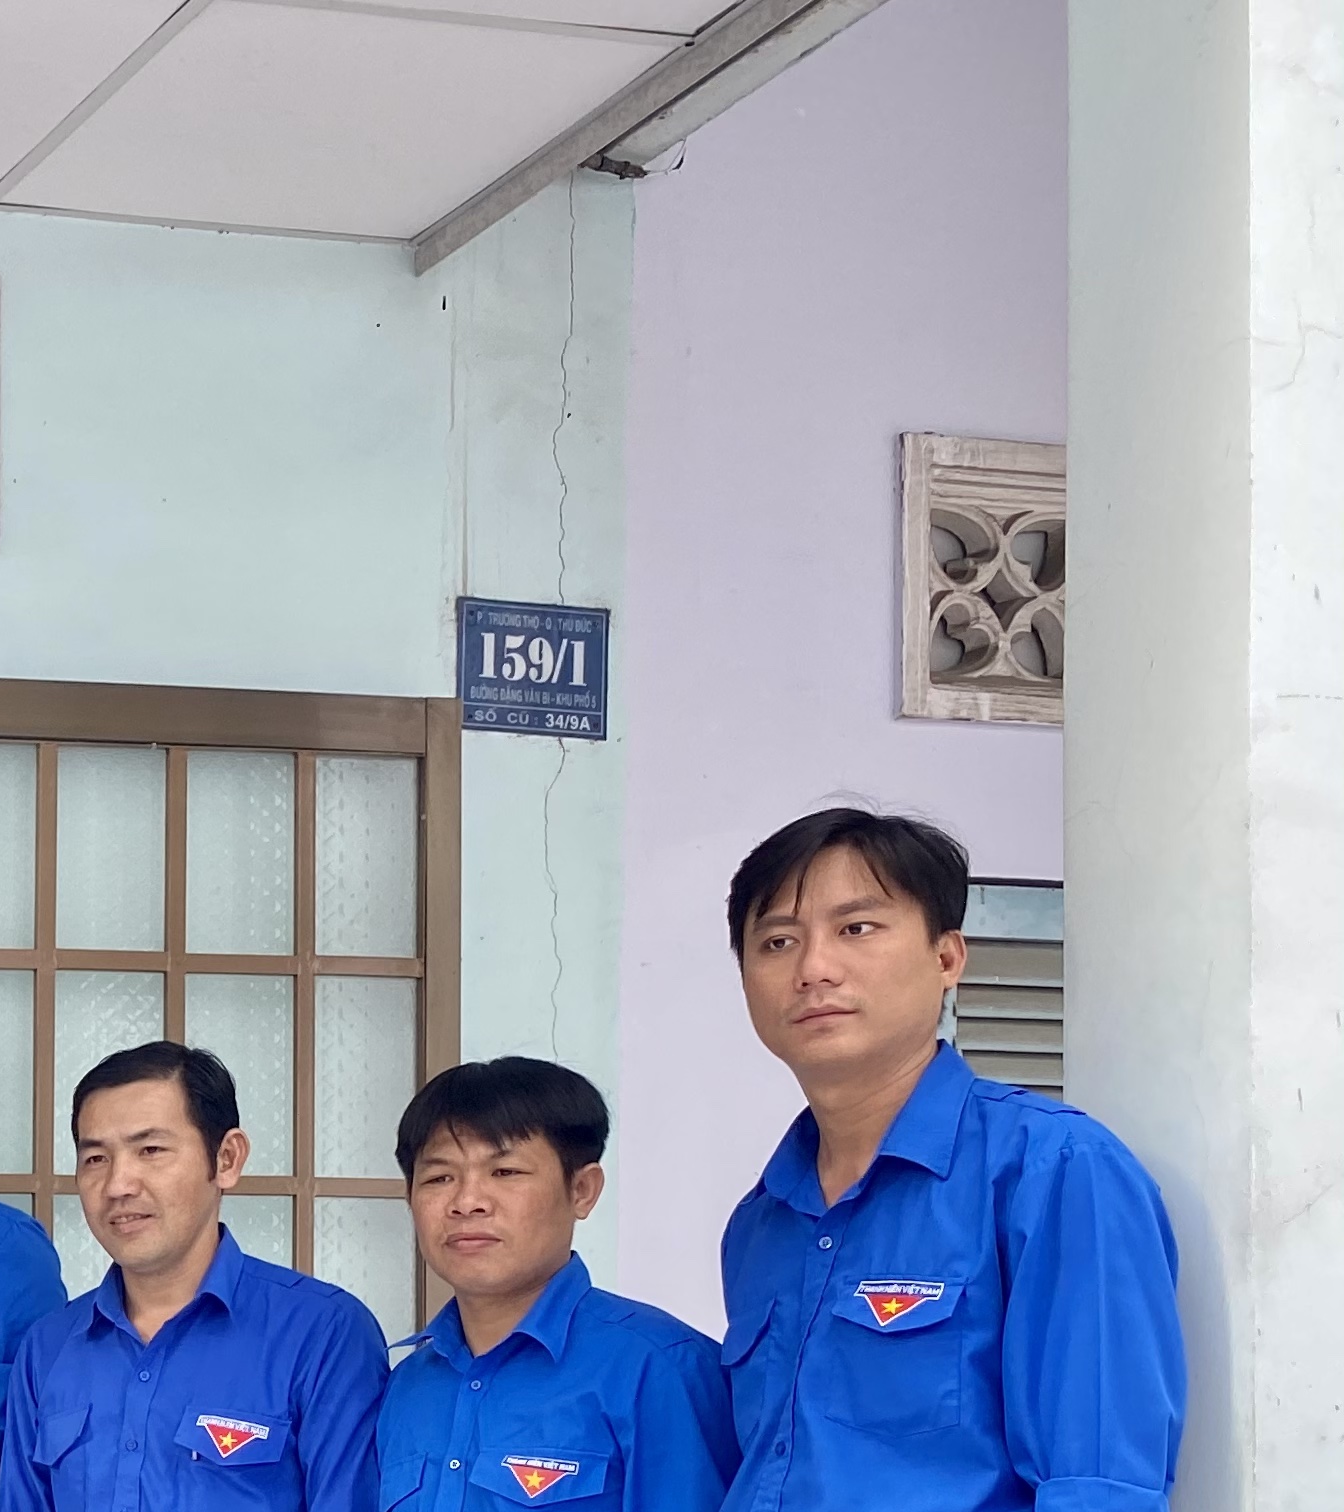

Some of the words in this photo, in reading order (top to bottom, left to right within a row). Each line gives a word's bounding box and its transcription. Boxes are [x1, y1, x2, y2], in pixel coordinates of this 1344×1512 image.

[478, 632, 587, 687] 159/1
[474, 706, 497, 722] SỐ
[507, 711, 529, 725] CŨ
[545, 713, 591, 731] 34/9A
